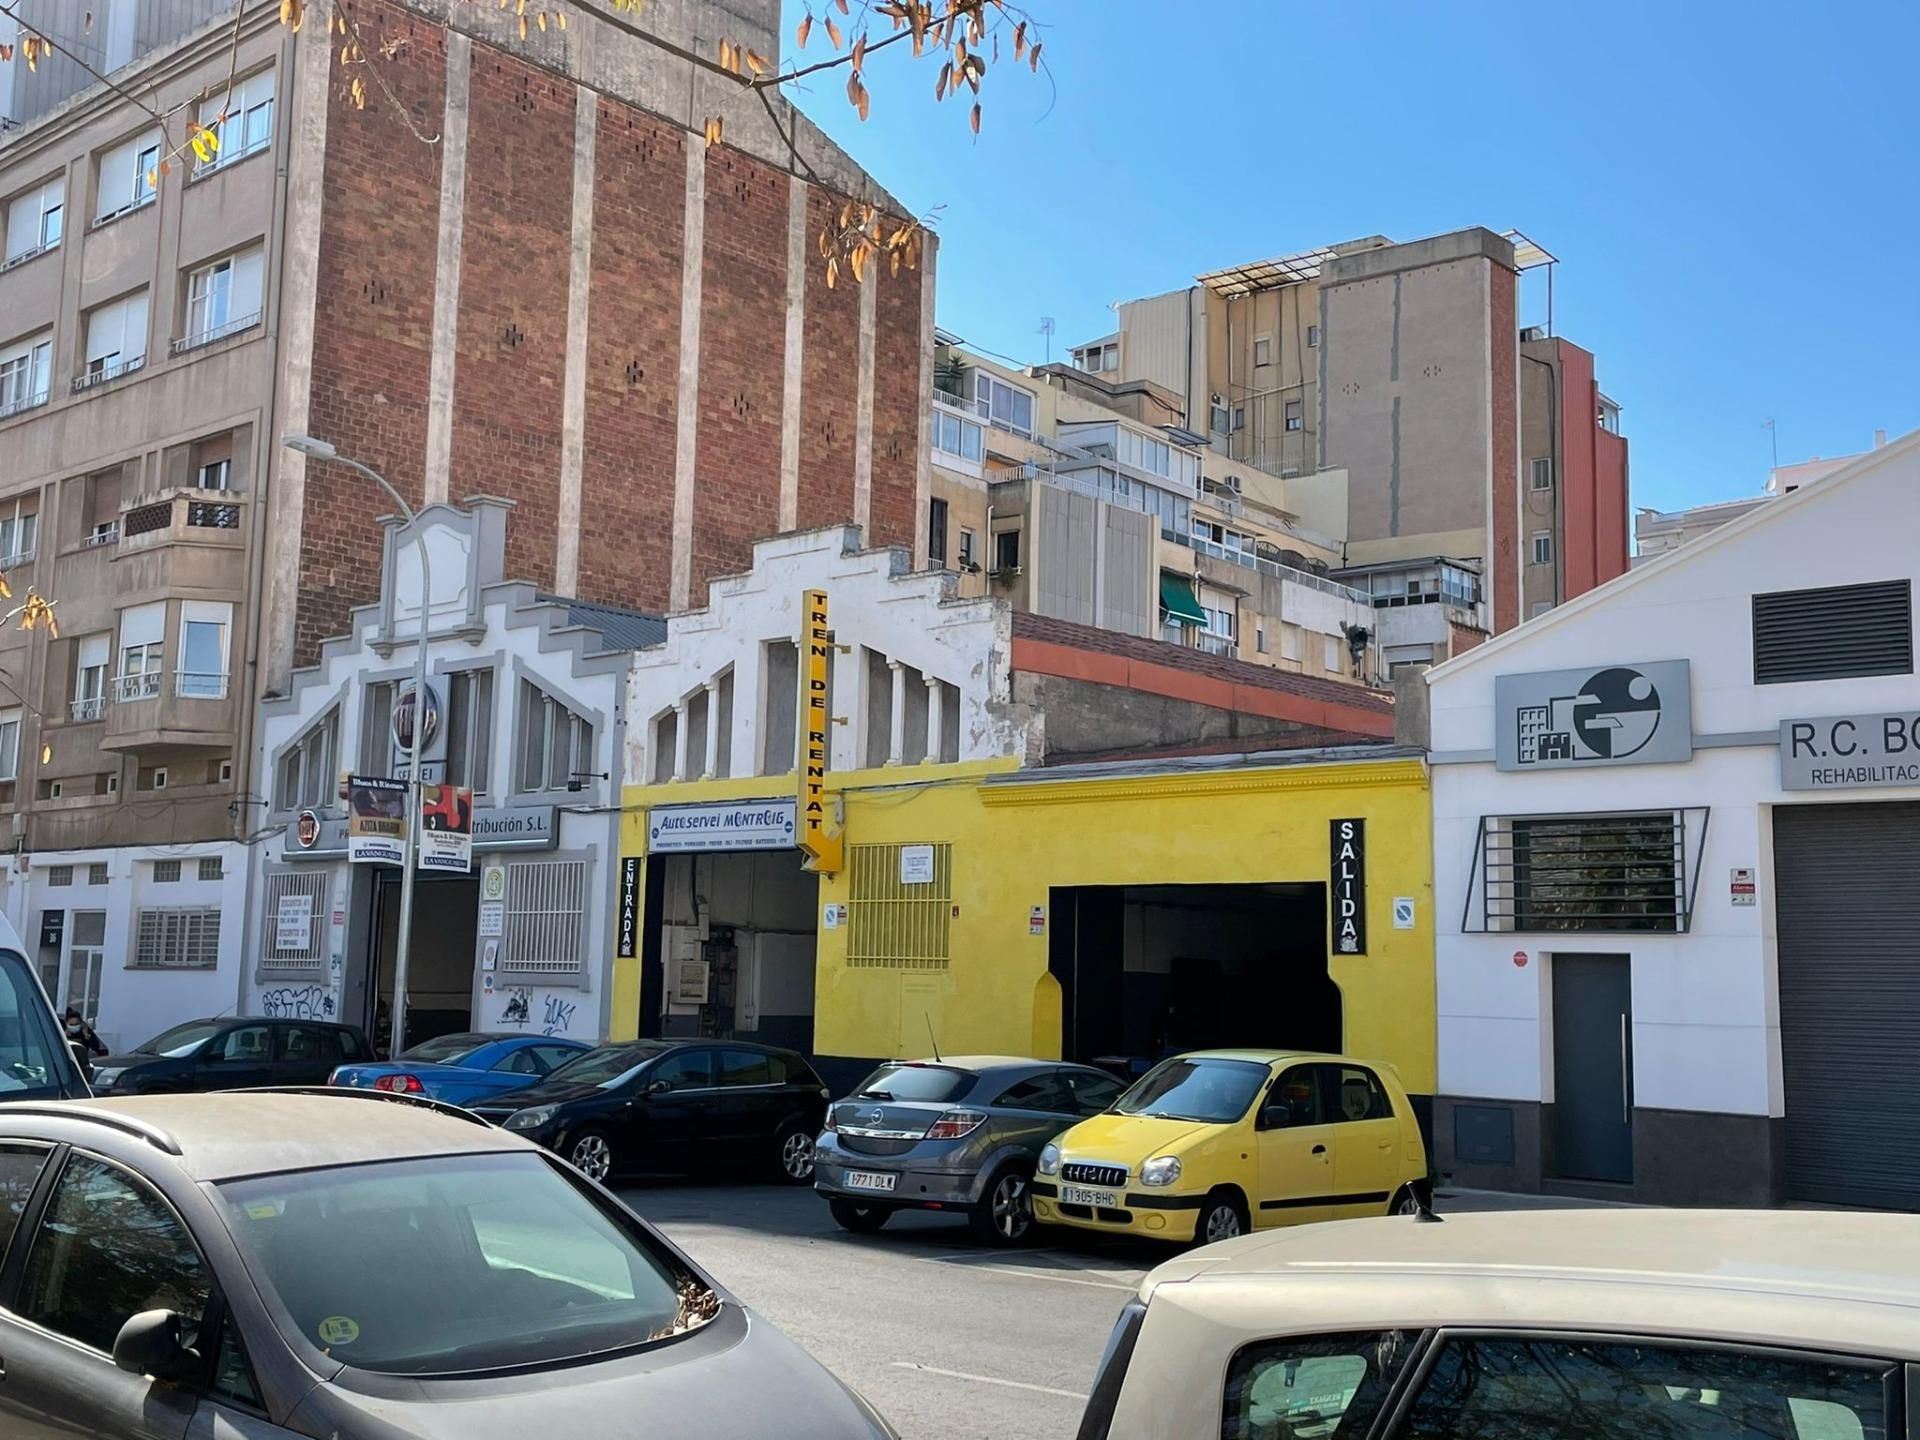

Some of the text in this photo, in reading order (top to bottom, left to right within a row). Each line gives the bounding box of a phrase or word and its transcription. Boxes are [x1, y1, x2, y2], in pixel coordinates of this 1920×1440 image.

[806, 593, 828, 830] TREN DE RENTAT
[1791, 720, 1868, 759] R.C.
[1811, 764, 1920, 784] REHABILITAC
[472, 817, 522, 833] tribución
[527, 815, 547, 831] S.L.
[660, 809, 785, 830] Autoservei MONTROIG
[1340, 822, 1356, 936] SALIDA
[622, 859, 635, 943] ENTRADA
[851, 1173, 872, 1188] 1771
[1069, 1190, 1114, 1206] 1305 BHC
